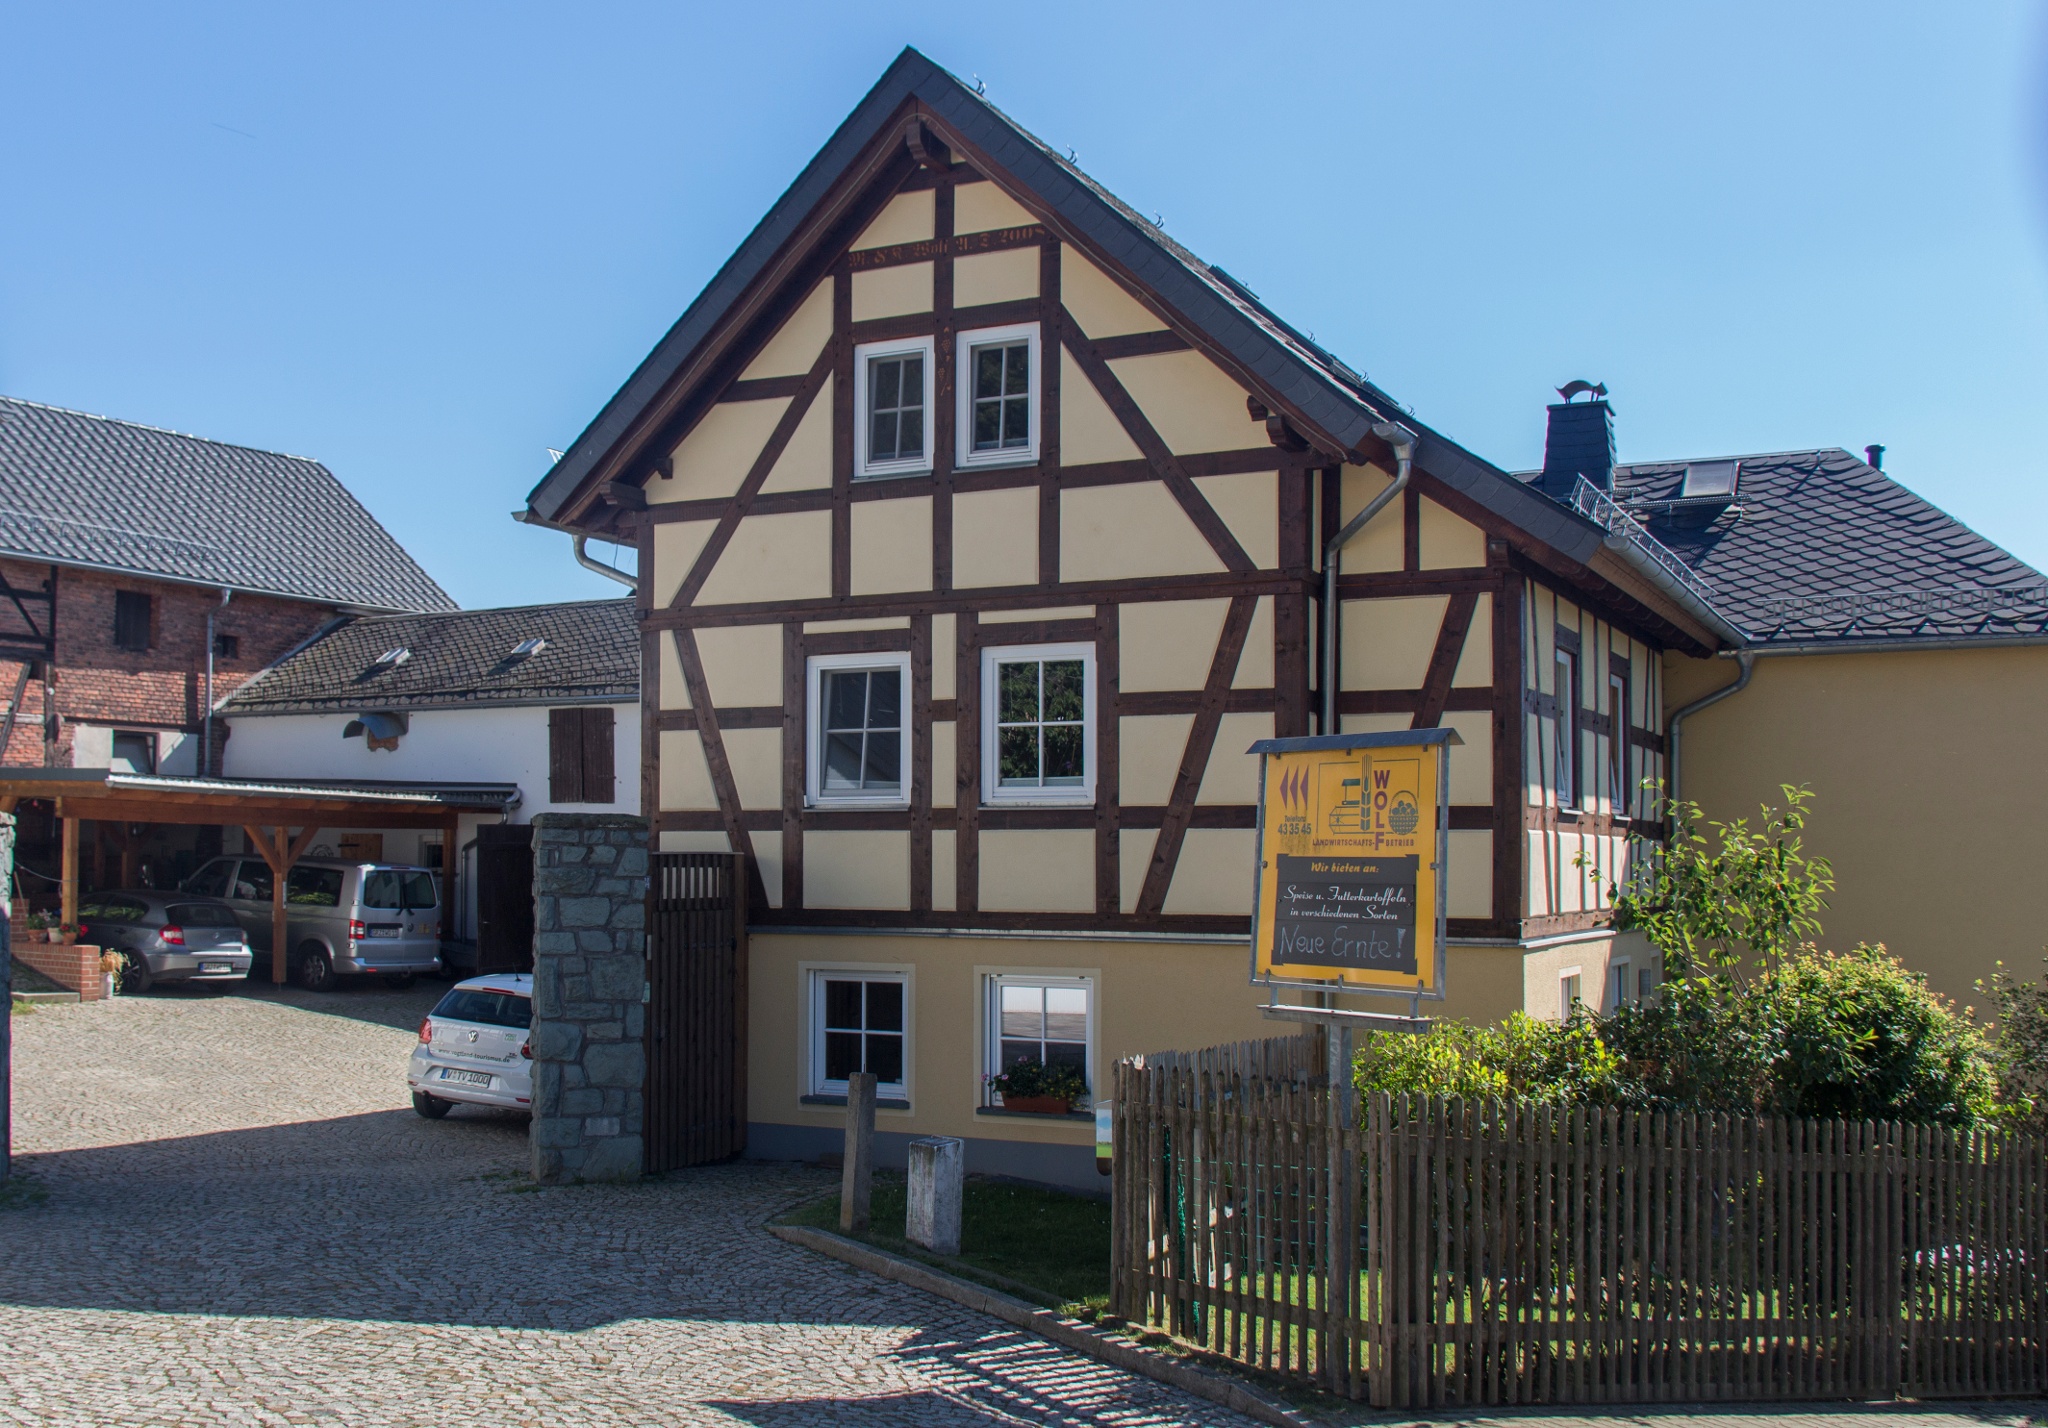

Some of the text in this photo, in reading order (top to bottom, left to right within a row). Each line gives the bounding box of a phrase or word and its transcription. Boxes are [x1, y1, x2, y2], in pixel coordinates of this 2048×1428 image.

[1373, 770, 1390, 850] WOLF
[1278, 823, 1312, 834] 43 35 45
[1385, 839, 1415, 847] BETRIEB
[1311, 862, 1379, 873] Wir bieten an:
[1283, 885, 1313, 903] Speise
[1327, 886, 1406, 906] Futterkartoffeln
[1290, 904, 1398, 920] in verschiedenen Sorten
[1280, 925, 1325, 955] Neue
[438, 1048, 510, 1063] www.vogtland-tourismus.de
[470, 1074, 489, 1085] 1000
